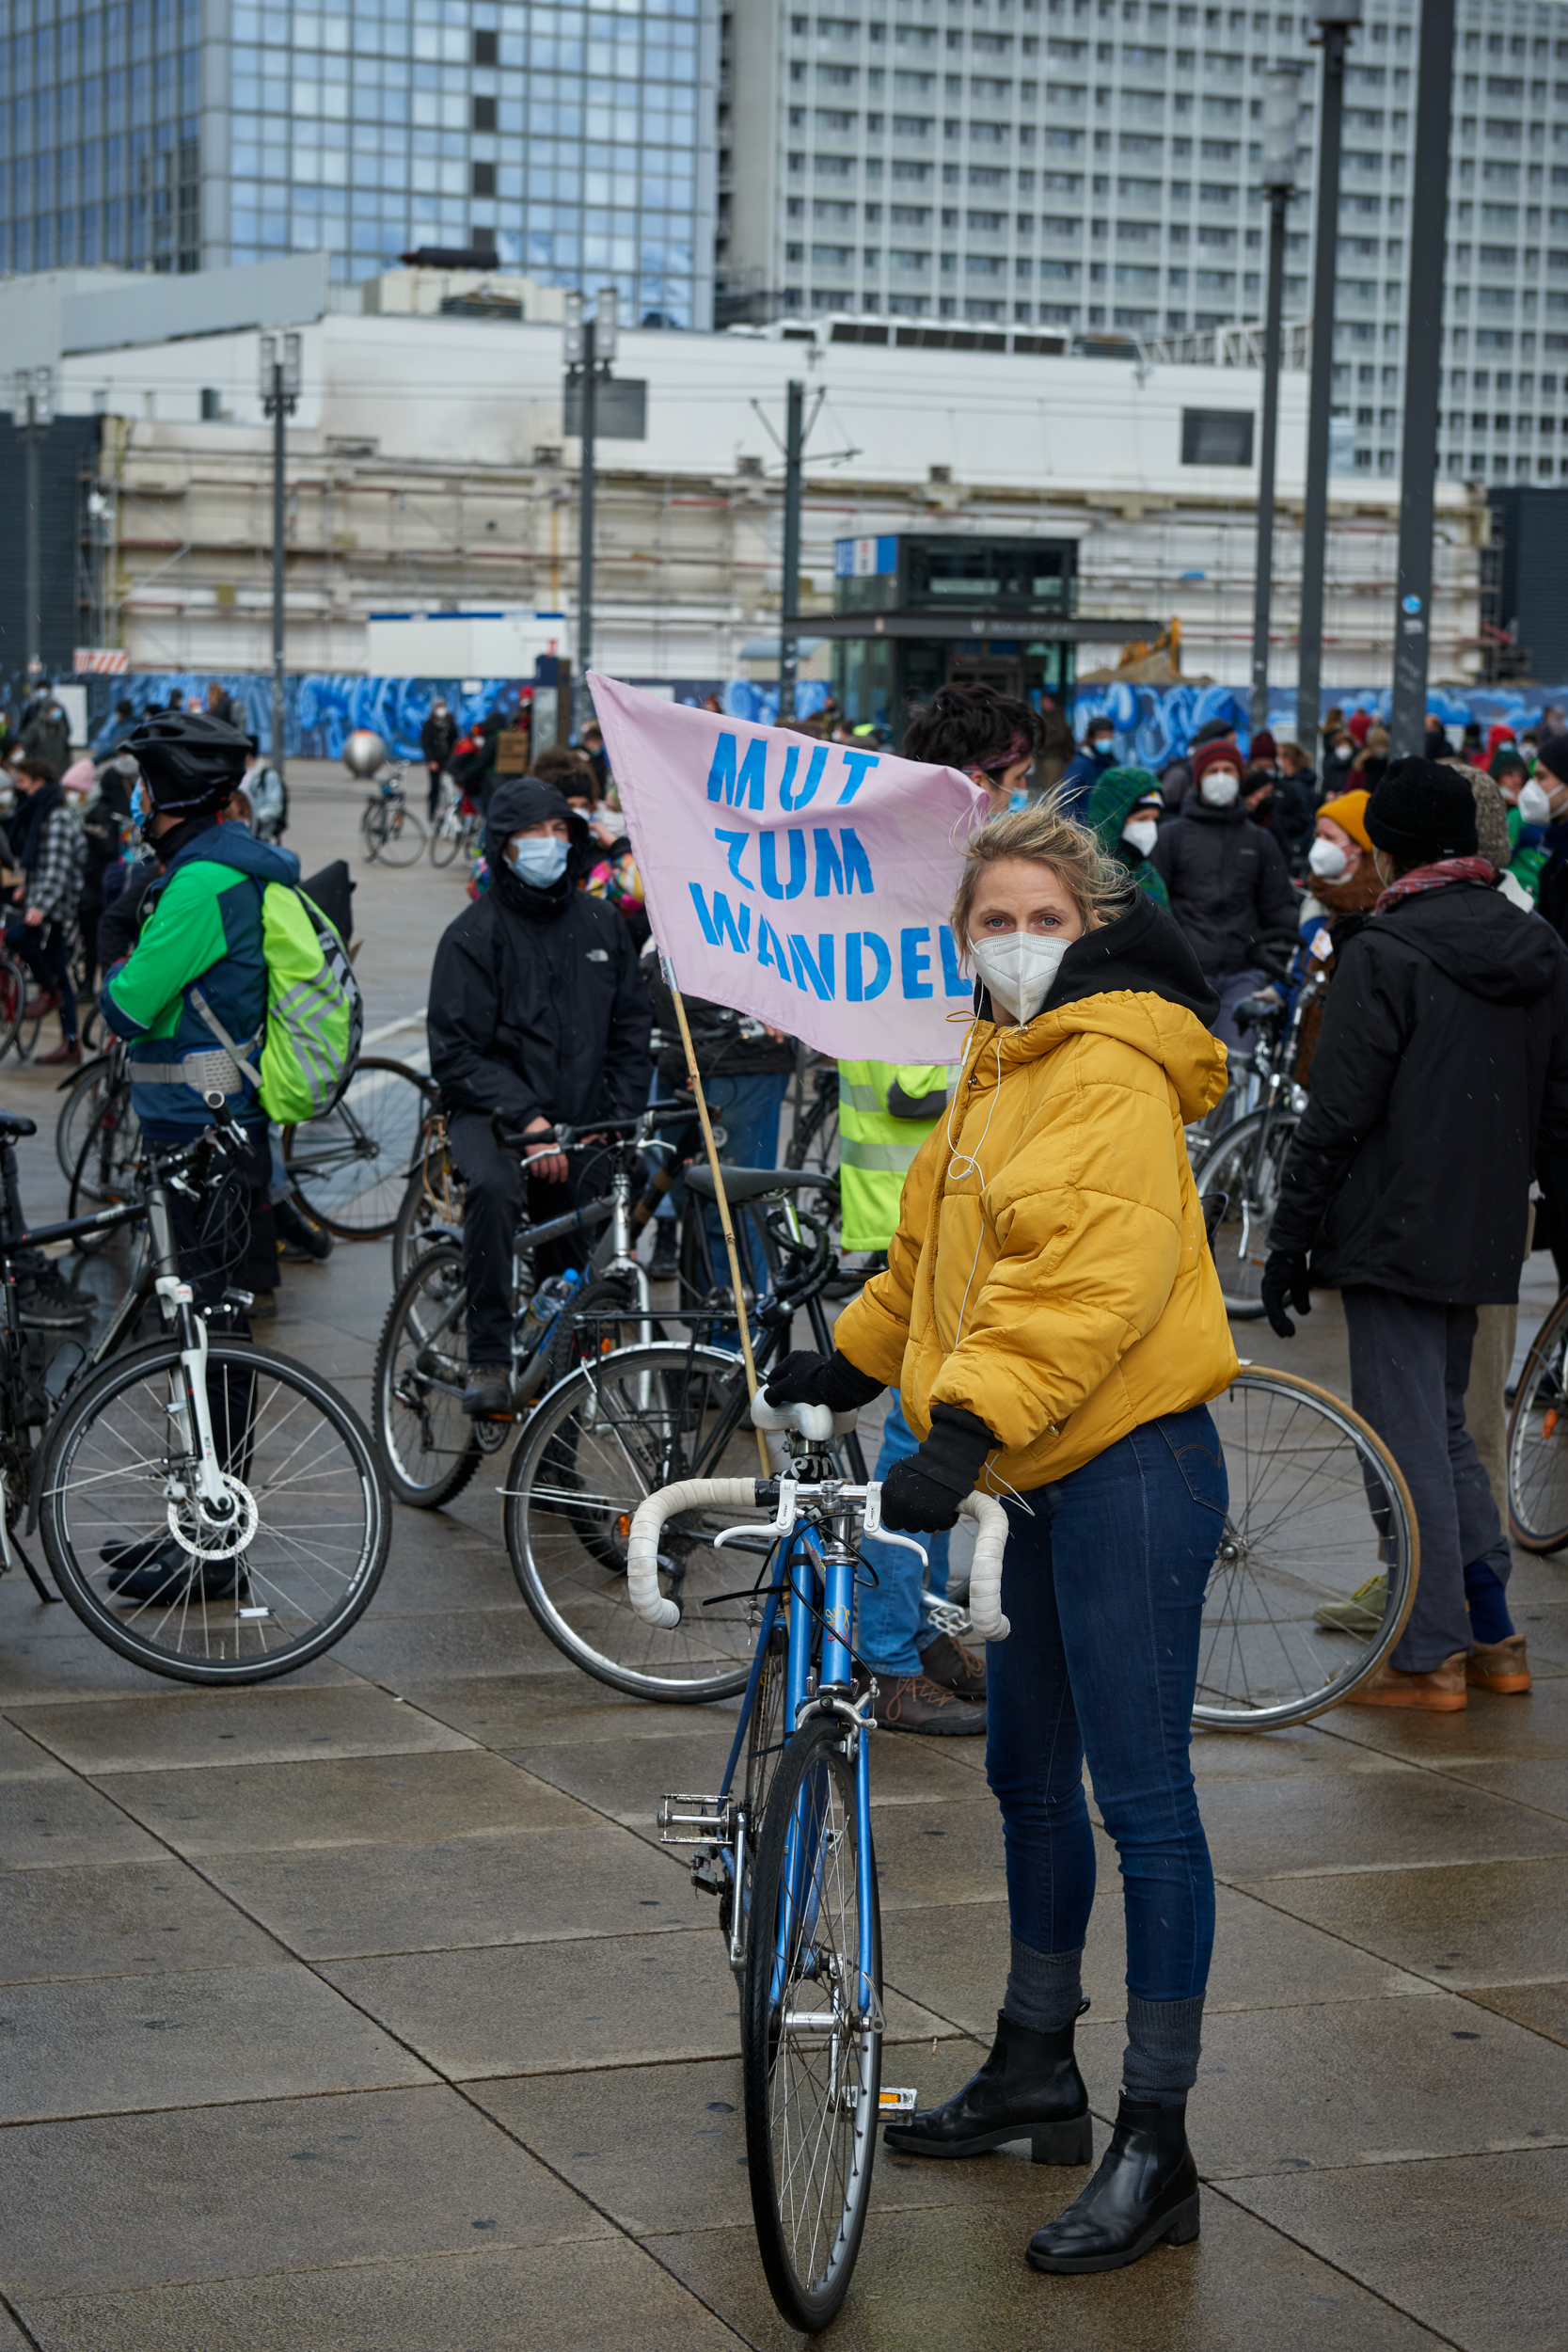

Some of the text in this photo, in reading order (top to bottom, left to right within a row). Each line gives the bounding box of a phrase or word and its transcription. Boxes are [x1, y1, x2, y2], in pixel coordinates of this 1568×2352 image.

[706, 732, 879, 811] MUT
[715, 827, 874, 900] ZUM
[688, 882, 974, 1002] WANDEL
